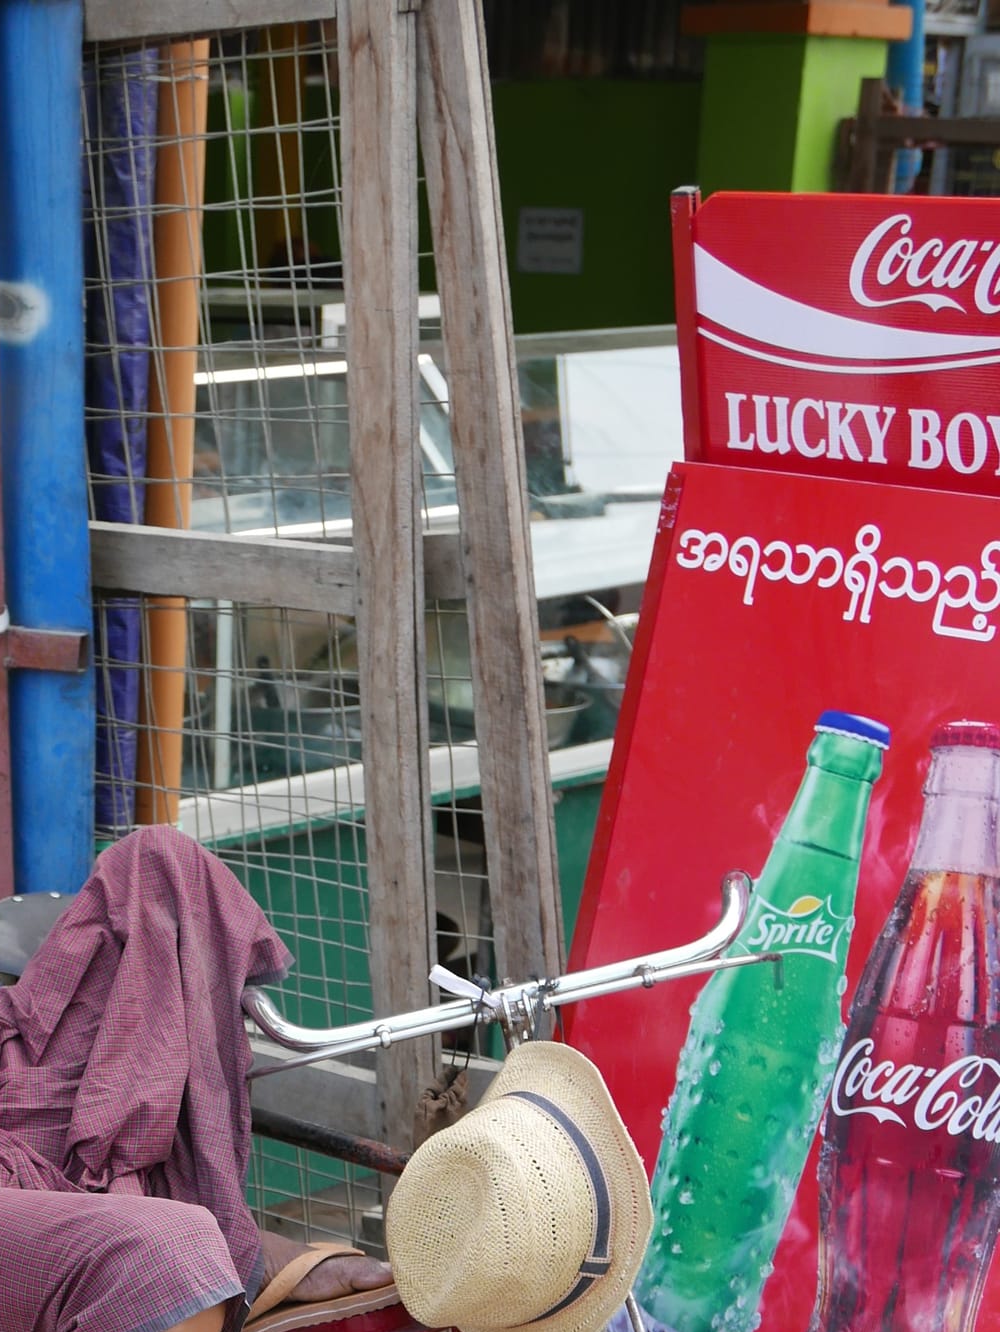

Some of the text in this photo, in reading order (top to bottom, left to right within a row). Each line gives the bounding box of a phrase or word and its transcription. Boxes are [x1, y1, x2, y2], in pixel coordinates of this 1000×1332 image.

[849, 214, 1000, 314] Coca-
[725, 392, 896, 464] LUCKY
[747, 911, 834, 951] Sprite
